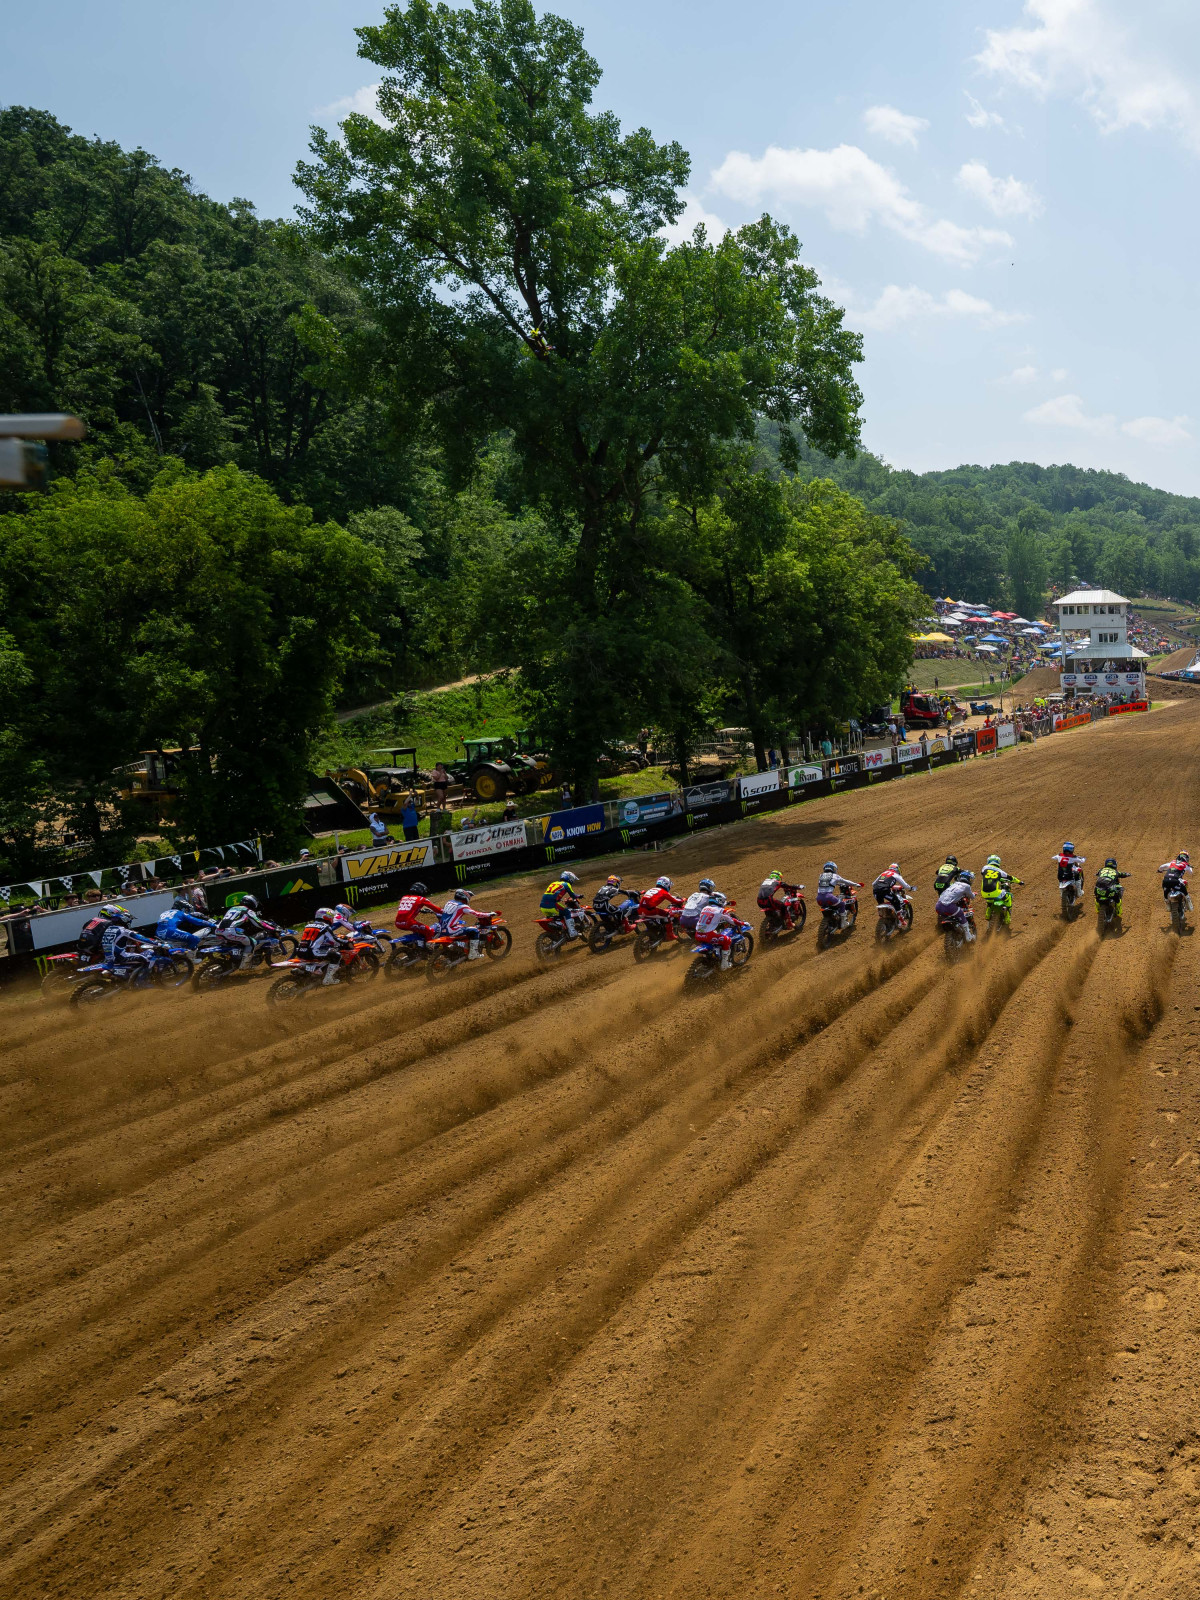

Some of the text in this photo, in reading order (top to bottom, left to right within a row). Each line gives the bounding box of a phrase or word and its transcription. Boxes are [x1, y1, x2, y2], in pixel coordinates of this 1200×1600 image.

[980, 734, 994, 747] KTM
[800, 772, 817, 782] Ryan
[750, 783, 778, 795] SCOTT
[566, 825, 586, 838] KNOW
[587, 821, 602, 833] HOW
[465, 837, 524, 856] HONDA YAMAHA
[554, 845, 576, 853] MONSTER
[346, 846, 429, 879] VAITH
[466, 863, 491, 871] MONSTER
[985, 869, 999, 879] 36
[358, 883, 389, 893] MONSTER
